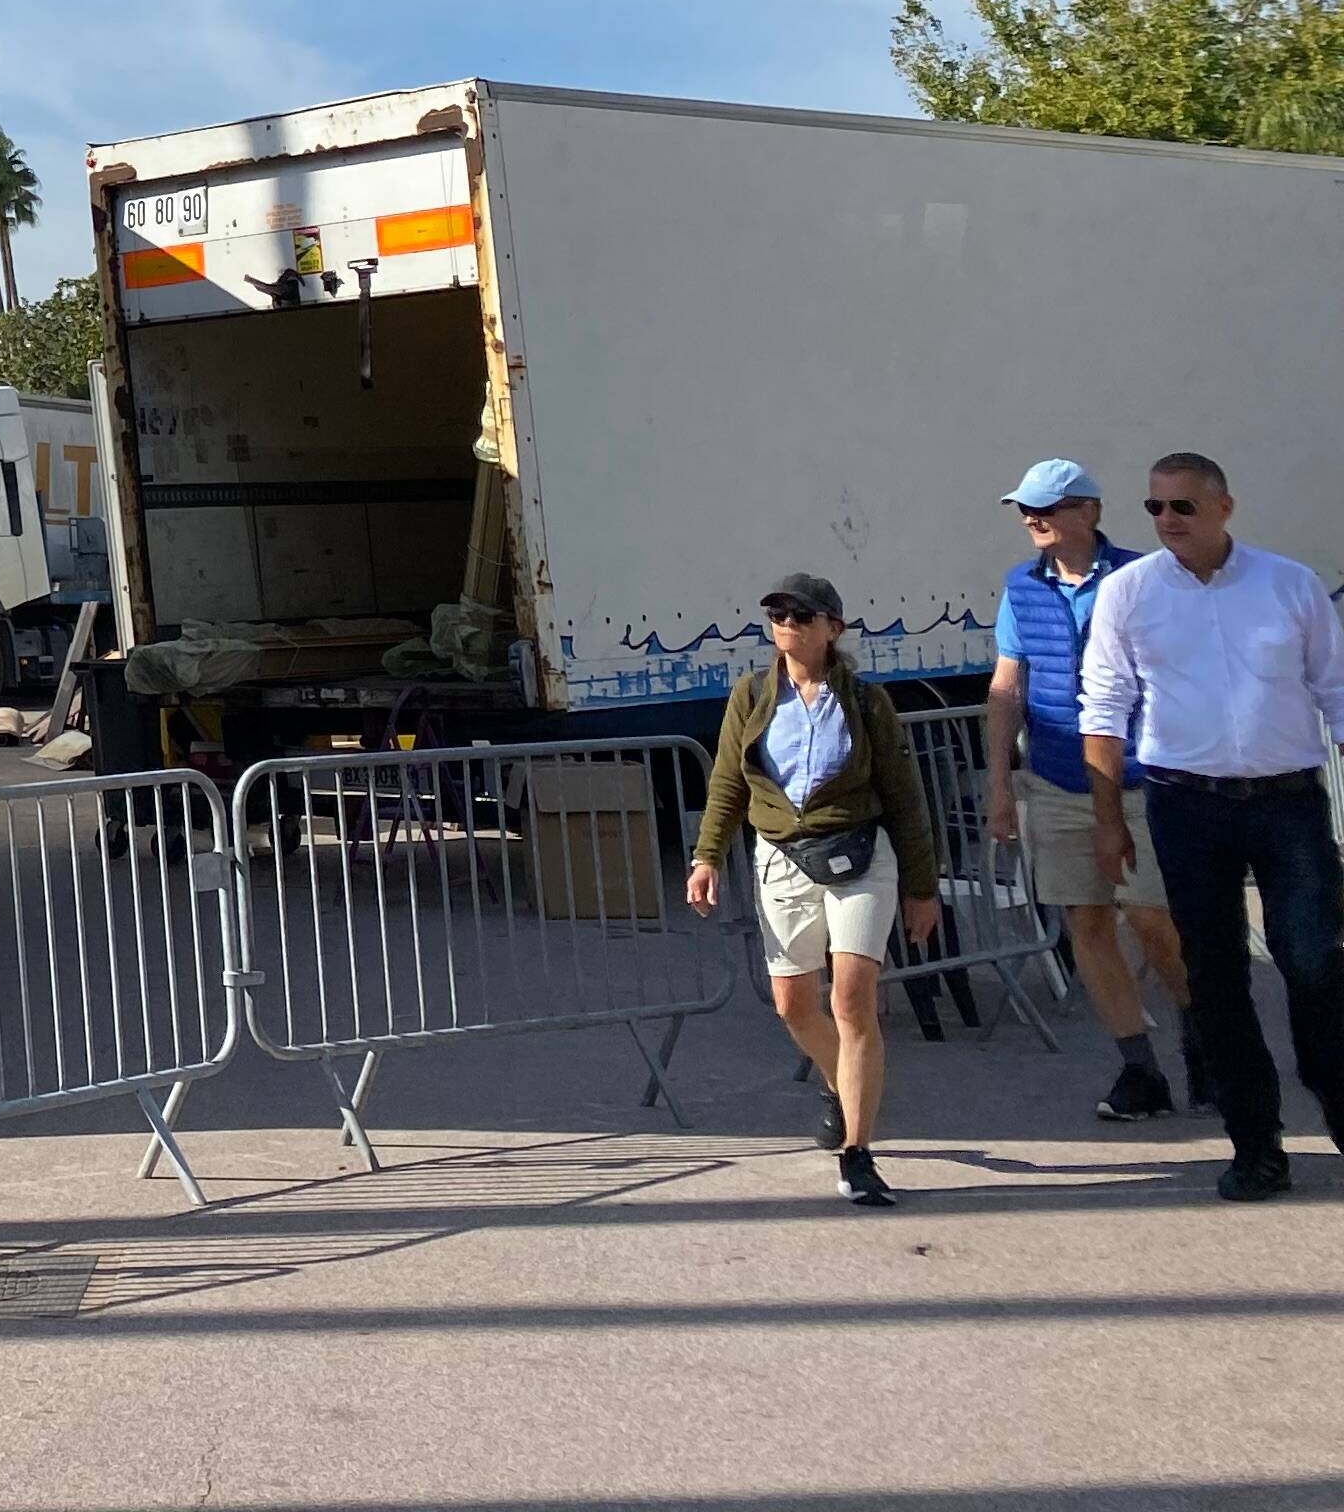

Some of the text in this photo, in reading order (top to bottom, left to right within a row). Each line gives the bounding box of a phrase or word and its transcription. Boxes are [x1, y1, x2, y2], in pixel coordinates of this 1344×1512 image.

[127, 193, 202, 229] 60 80 90
